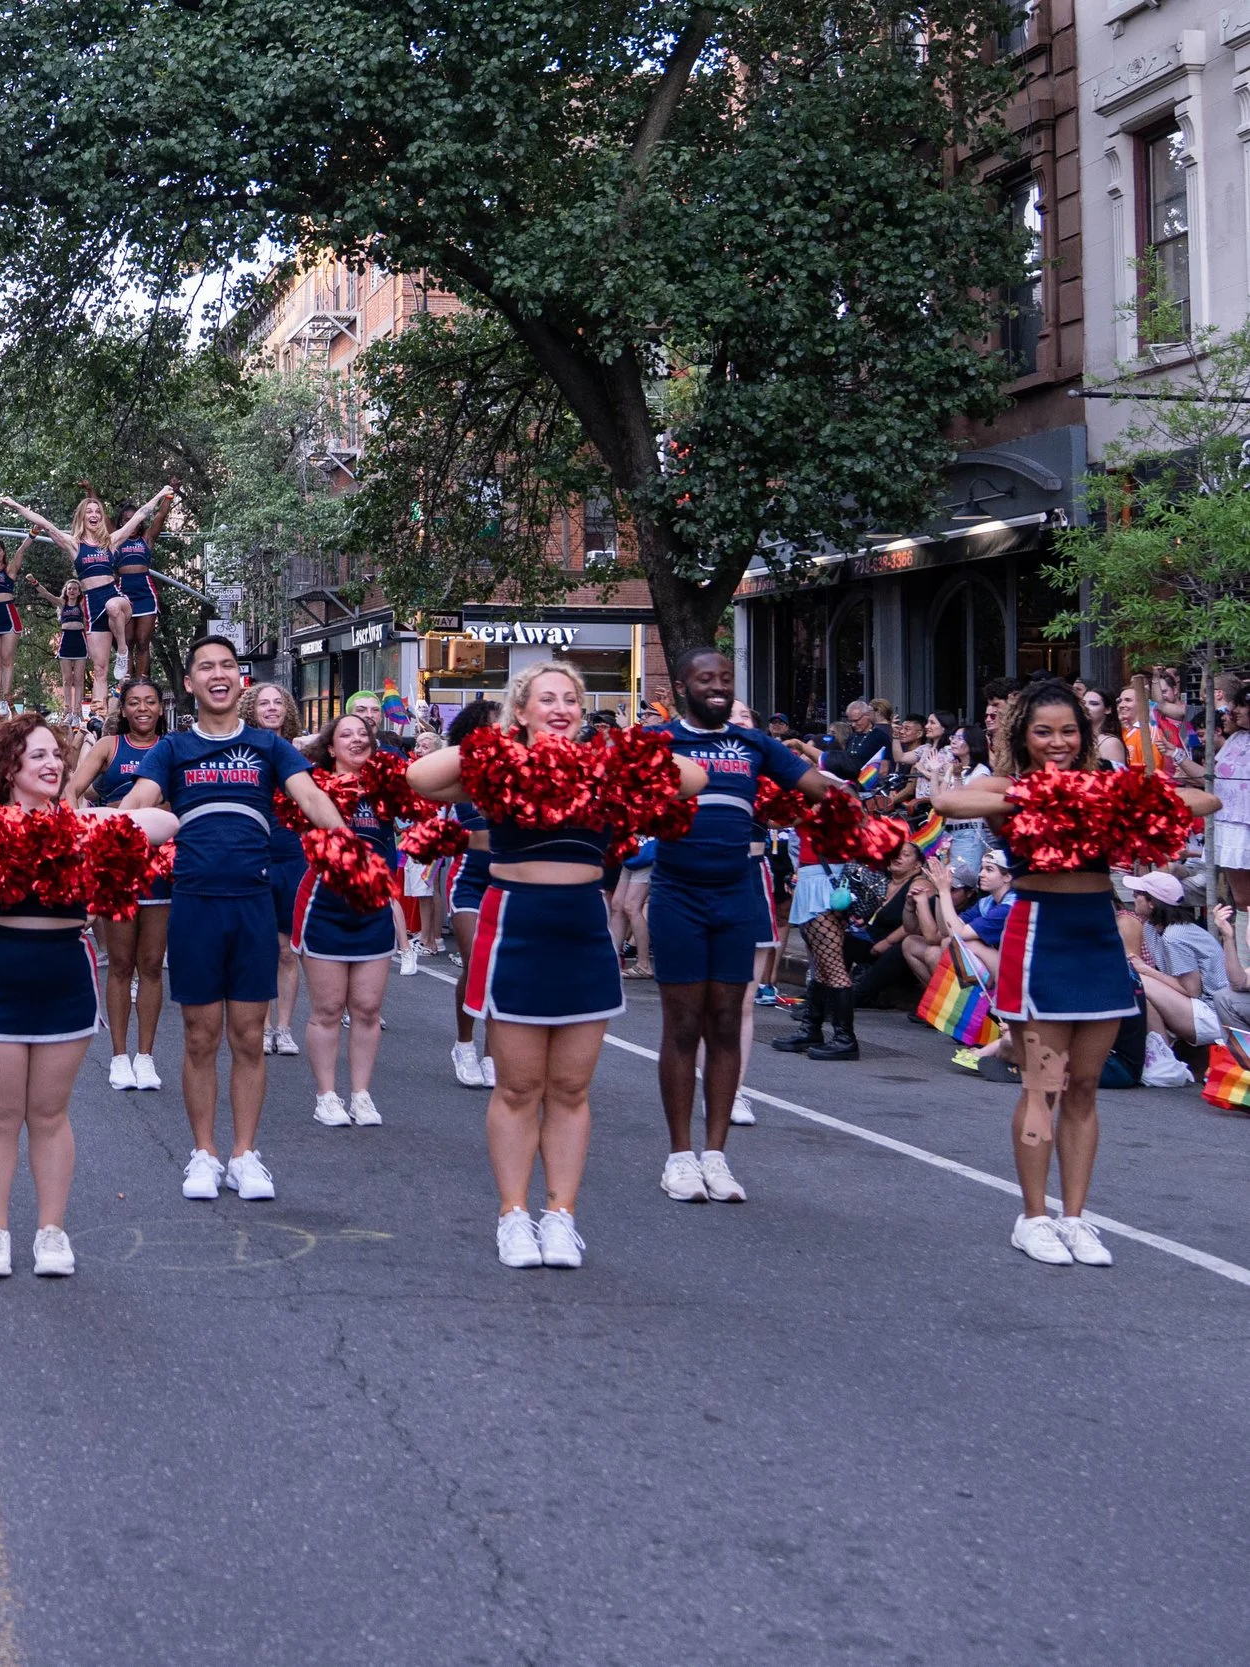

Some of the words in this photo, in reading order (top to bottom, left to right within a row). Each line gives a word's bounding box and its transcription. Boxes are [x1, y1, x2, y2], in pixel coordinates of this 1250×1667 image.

[442, 621, 580, 651] serAway
[690, 750, 736, 759] CHEER
[184, 769, 219, 786] NEW
[220, 768, 260, 786] YORK
[710, 759, 753, 778] YORK
